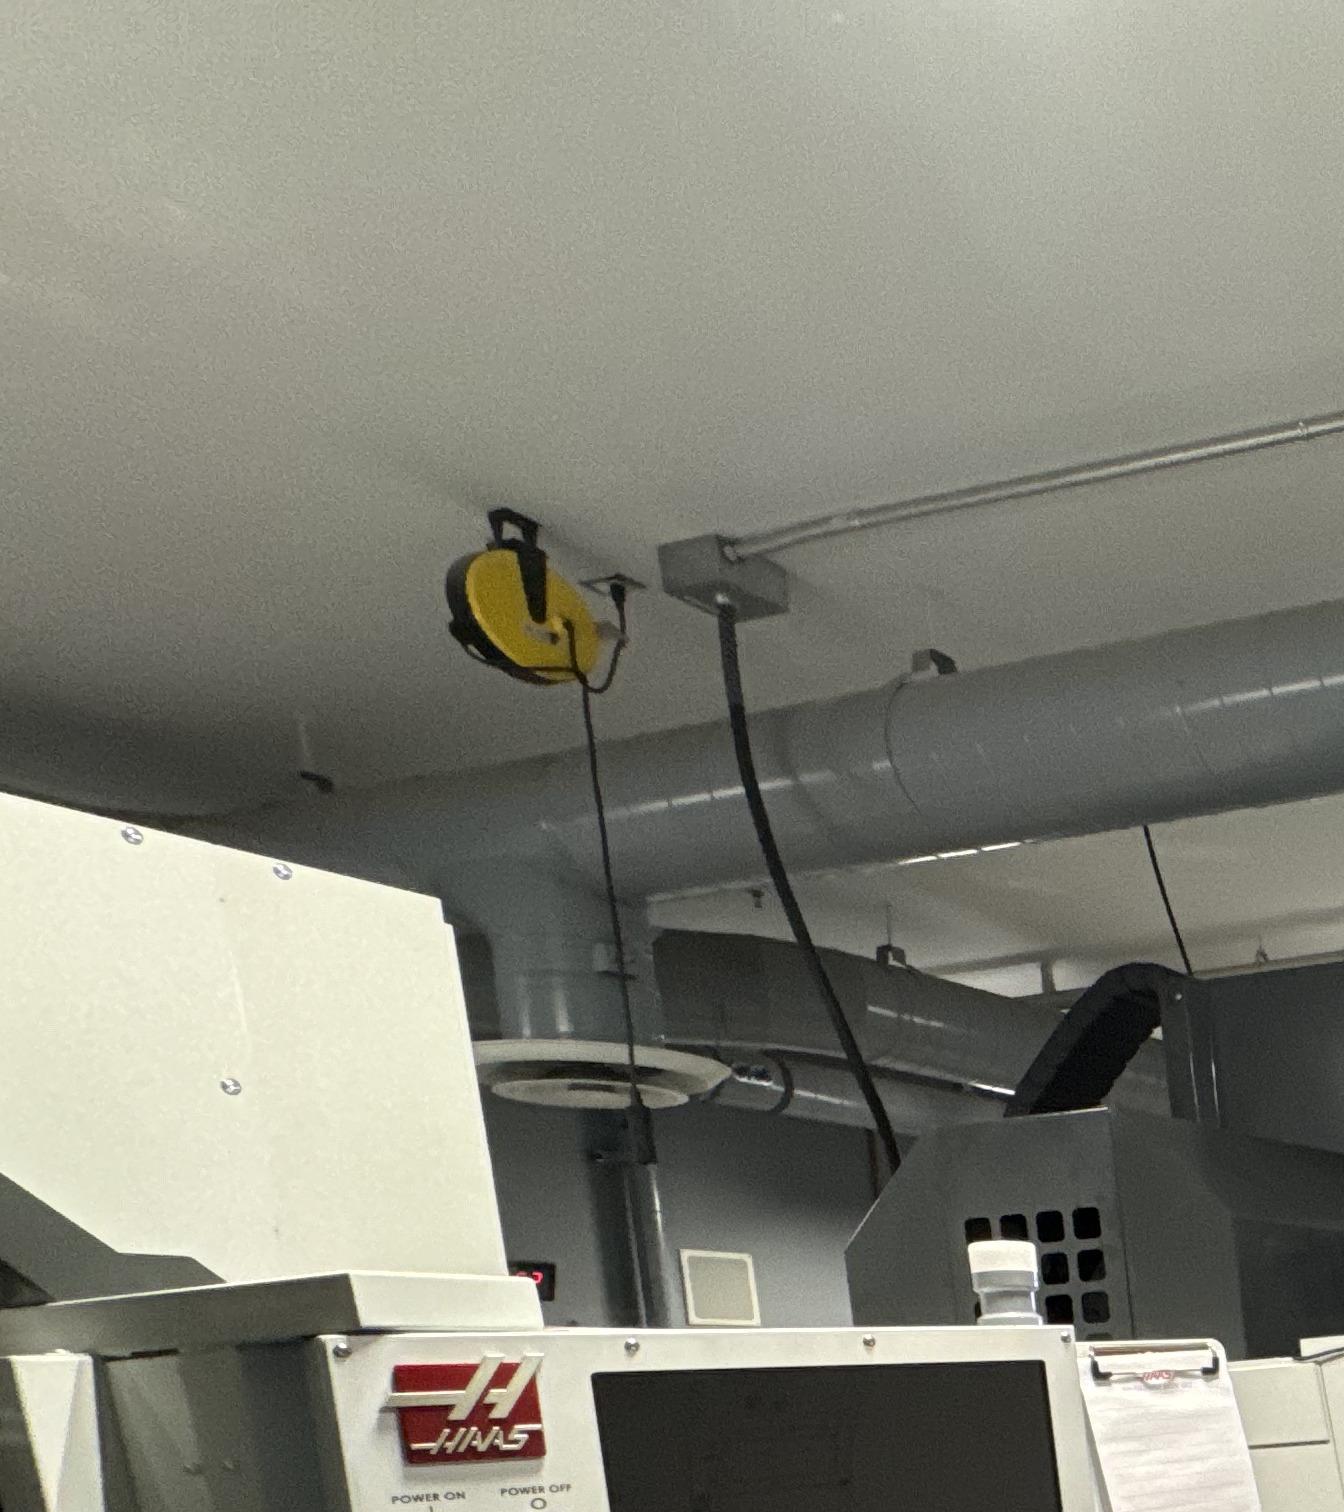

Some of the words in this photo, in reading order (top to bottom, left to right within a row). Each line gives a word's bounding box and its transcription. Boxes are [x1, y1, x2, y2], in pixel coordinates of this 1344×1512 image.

[411, 1423, 543, 1455] HAAS
[500, 1485, 545, 1497] POWER
[549, 1483, 572, 1494] OFF
[391, 1492, 440, 1505] POWER
[443, 1491, 466, 1501] ON
